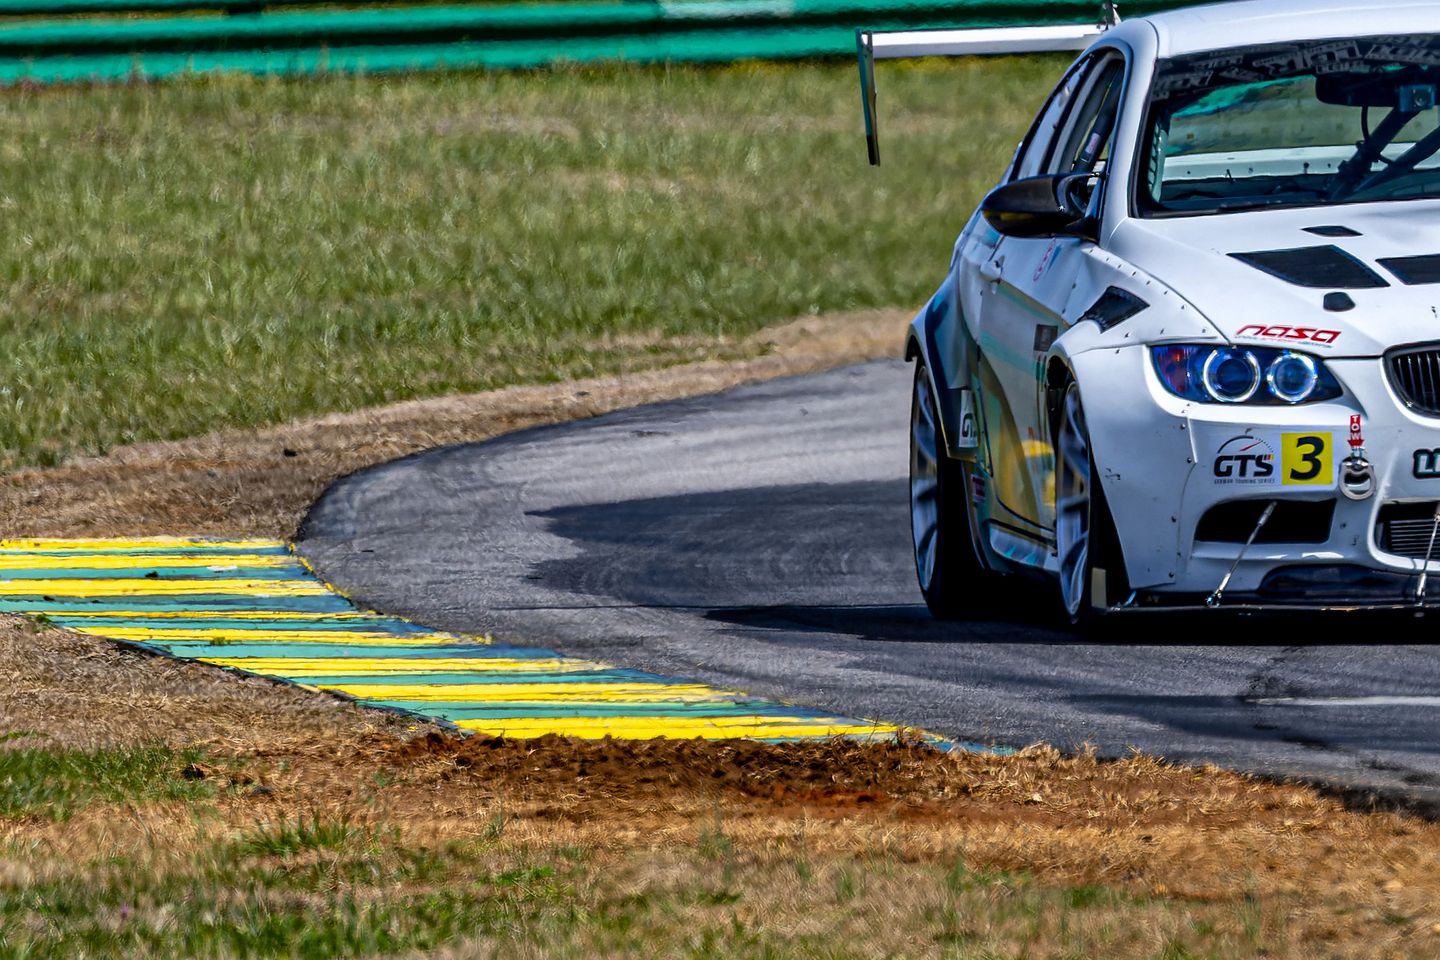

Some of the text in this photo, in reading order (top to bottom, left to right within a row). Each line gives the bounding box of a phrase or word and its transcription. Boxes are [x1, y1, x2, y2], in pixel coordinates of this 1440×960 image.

[1350, 415, 1361, 440] TOW
[1213, 454, 1274, 477] GTS
[1289, 435, 1325, 481] 3
